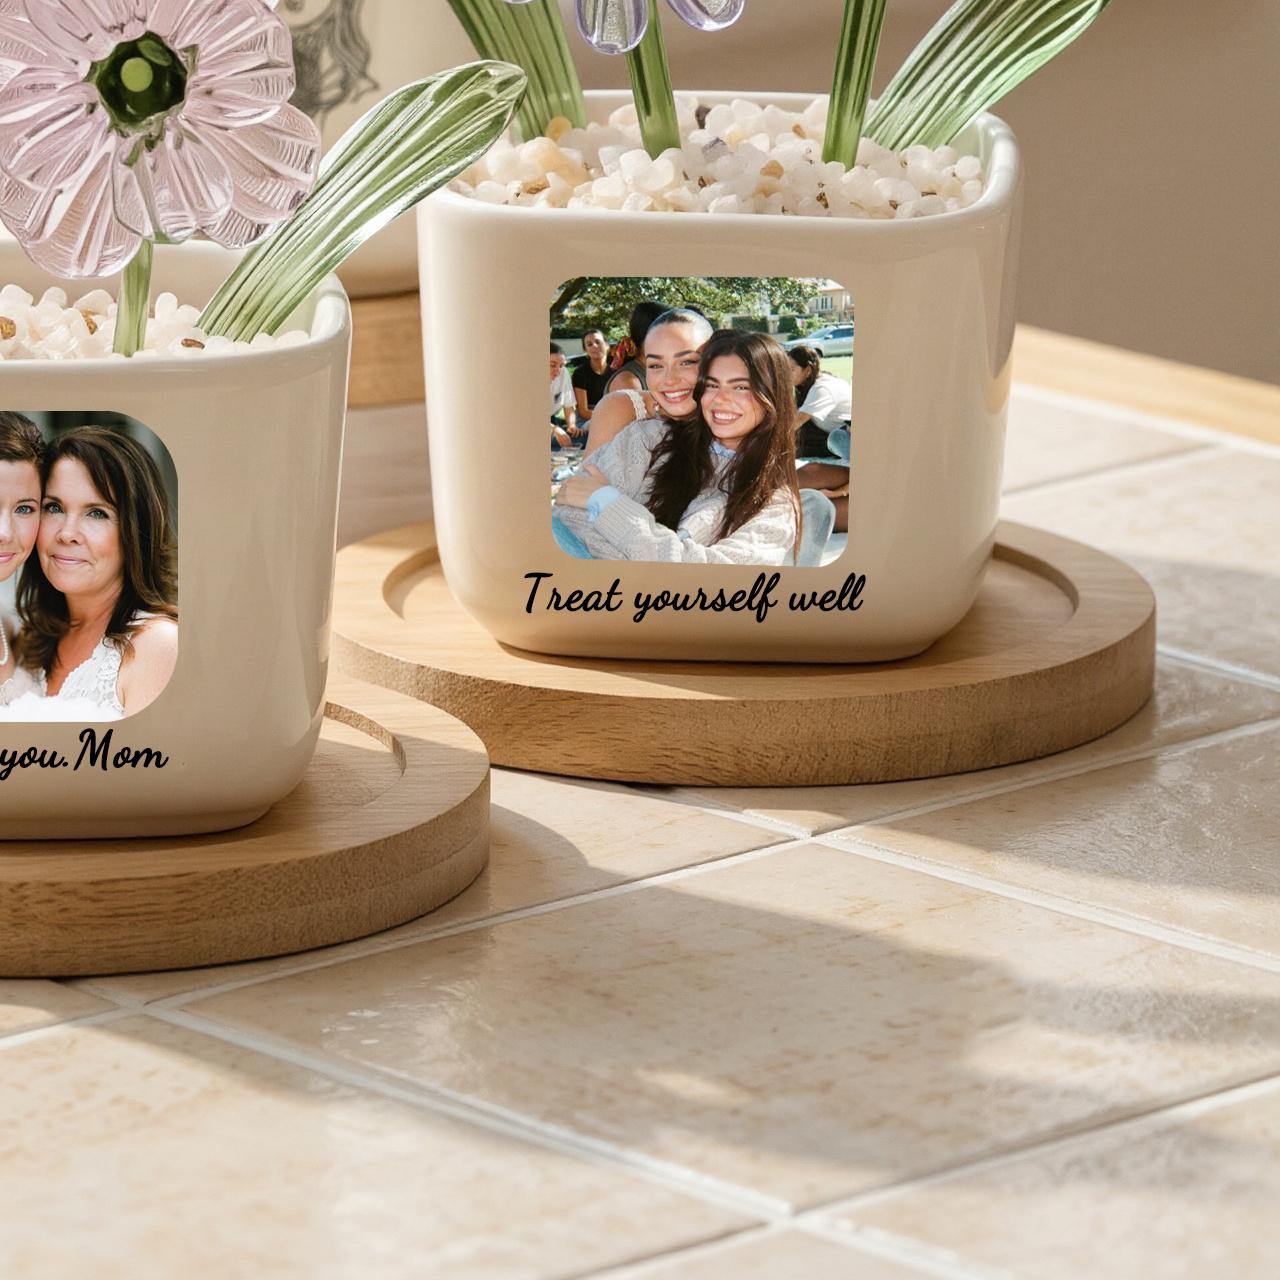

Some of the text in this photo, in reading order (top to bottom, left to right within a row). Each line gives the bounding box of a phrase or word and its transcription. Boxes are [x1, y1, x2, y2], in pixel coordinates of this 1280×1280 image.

[523, 571, 867, 624] Treat yourself well
